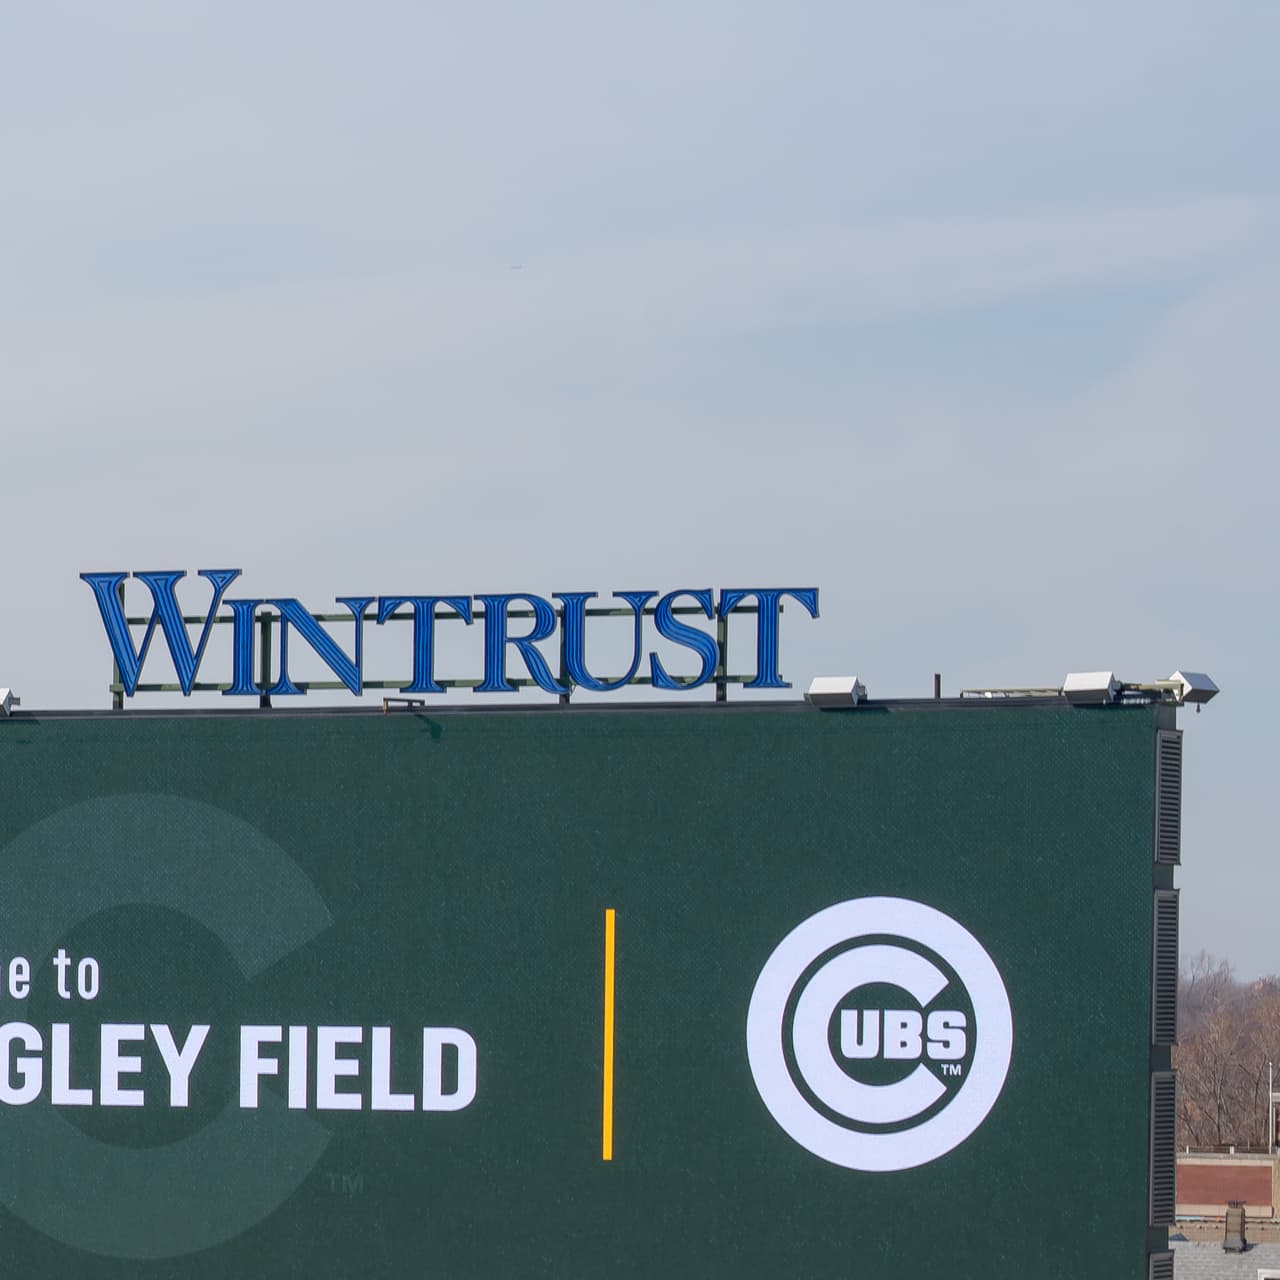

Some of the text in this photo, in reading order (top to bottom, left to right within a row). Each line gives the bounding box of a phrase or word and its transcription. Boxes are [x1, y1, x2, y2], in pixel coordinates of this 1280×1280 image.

[80, 567, 820, 697] WINTRUST
[53, 948, 99, 1000] to
[239, 1024, 477, 1112] FIELD
[941, 1064, 962, 1076] TM
